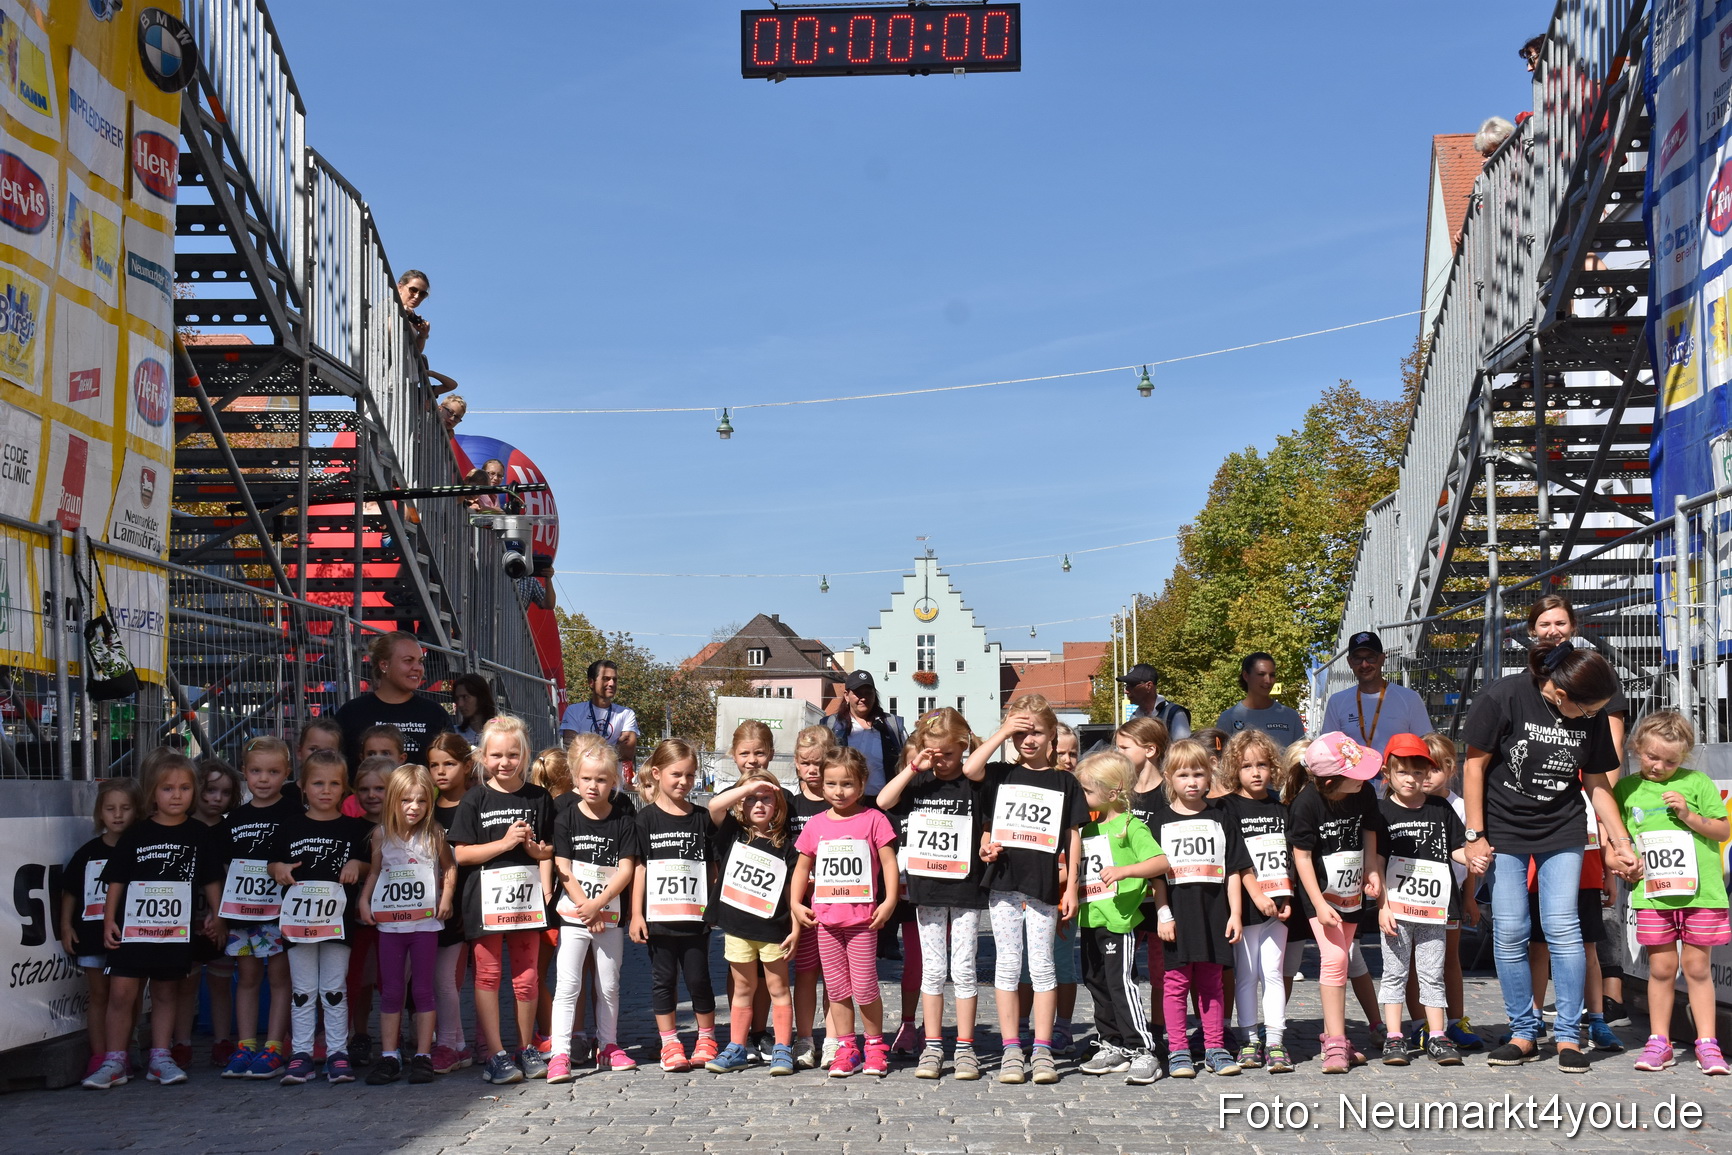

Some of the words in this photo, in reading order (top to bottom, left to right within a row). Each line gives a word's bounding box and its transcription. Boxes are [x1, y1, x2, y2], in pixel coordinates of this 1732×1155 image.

[140, 11, 192, 46] BMW
[753, 11, 1010, 65] 00:00:00
[20, 79, 48, 110] KANN
[77, 95, 124, 151] PFLEIDERER
[137, 138, 178, 187] Hervi
[137, 366, 168, 414] Hervis
[4, 443, 29, 466] CODE
[1, 462, 32, 486] CLINIC
[59, 485, 82, 515] Braun
[124, 509, 160, 532] Neumarkter
[1524, 721, 1587, 740] NEUMARKTER
[1528, 731, 1582, 748] STADTLAUF
[1015, 790, 1044, 801] BOCK
[481, 808, 523, 819] Neumarkter
[1005, 801, 1052, 825] 7432
[481, 816, 515, 828] Stadtlauf
[926, 819, 953, 827] BOCK
[1387, 820, 1429, 832] Neumarkter
[290, 836, 334, 849] Neumarkter
[650, 831, 692, 840] Neumarkter
[651, 839, 684, 849] Stadtlauf
[917, 830, 959, 852] 7431
[1012, 830, 1037, 843] Emma
[136, 842, 182, 855] Neumarkter
[828, 845, 854, 853] BOCK
[1171, 836, 1216, 857] 7501
[388, 869, 415, 879] BOCK
[822, 857, 863, 877] 7500
[926, 860, 948, 871] Luise
[1404, 863, 1433, 874] BOCK
[500, 871, 527, 881] BOCK
[732, 860, 776, 892] 7552
[234, 875, 278, 896] 7032
[380, 880, 426, 903] 7099
[656, 875, 698, 895] 7517
[831, 887, 850, 896] Julia
[1395, 874, 1442, 898] 7350
[1655, 880, 1672, 890] Lisa
[491, 883, 534, 905] 7347
[135, 898, 182, 918] 7030
[240, 905, 265, 915] Emma
[291, 897, 337, 918] 7110
[391, 911, 412, 921] Viola
[1403, 905, 1429, 916] Liliane
[497, 914, 532, 924] Franziska
[138, 927, 174, 937] Charlotte
[304, 927, 318, 936] Eva
